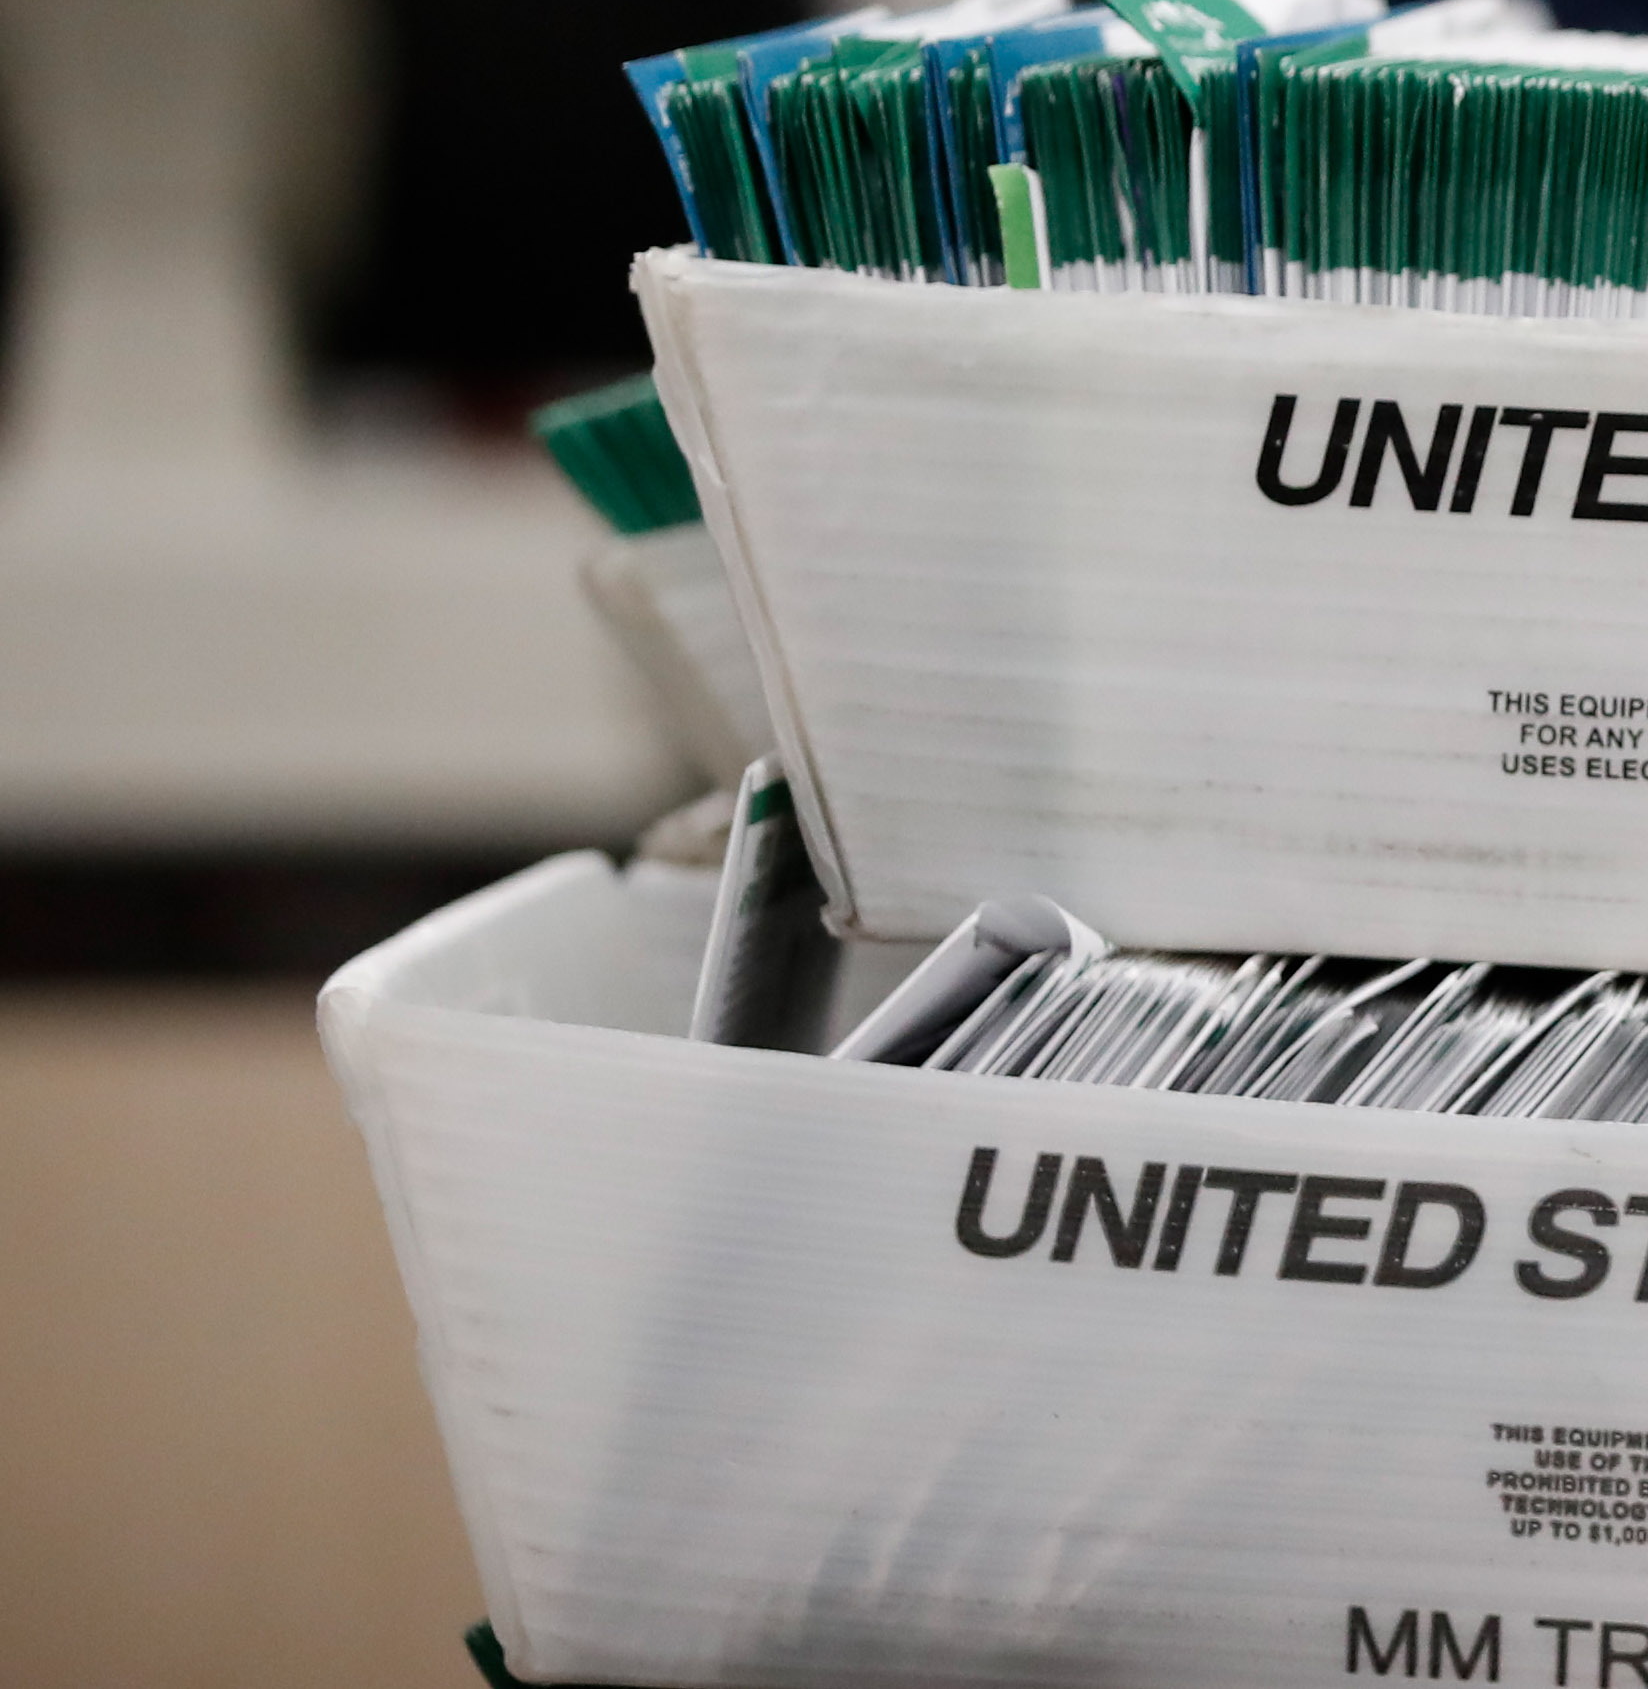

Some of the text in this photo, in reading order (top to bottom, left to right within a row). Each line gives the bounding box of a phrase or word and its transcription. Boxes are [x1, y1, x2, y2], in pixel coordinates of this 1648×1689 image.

[1487, 690, 1550, 717] THIS
[1519, 722, 1578, 748] FOR
[1584, 726, 1645, 750] ANY
[1500, 753, 1578, 778] USES
[954, 1146, 1488, 1291] UNITED
[1491, 1423, 1545, 1444] THIS
[1486, 1471, 1632, 1497] PROHIBITED
[1510, 1519, 1543, 1537] UP
[1549, 1520, 1582, 1540] TO
[1345, 1605, 1502, 1684] MM
